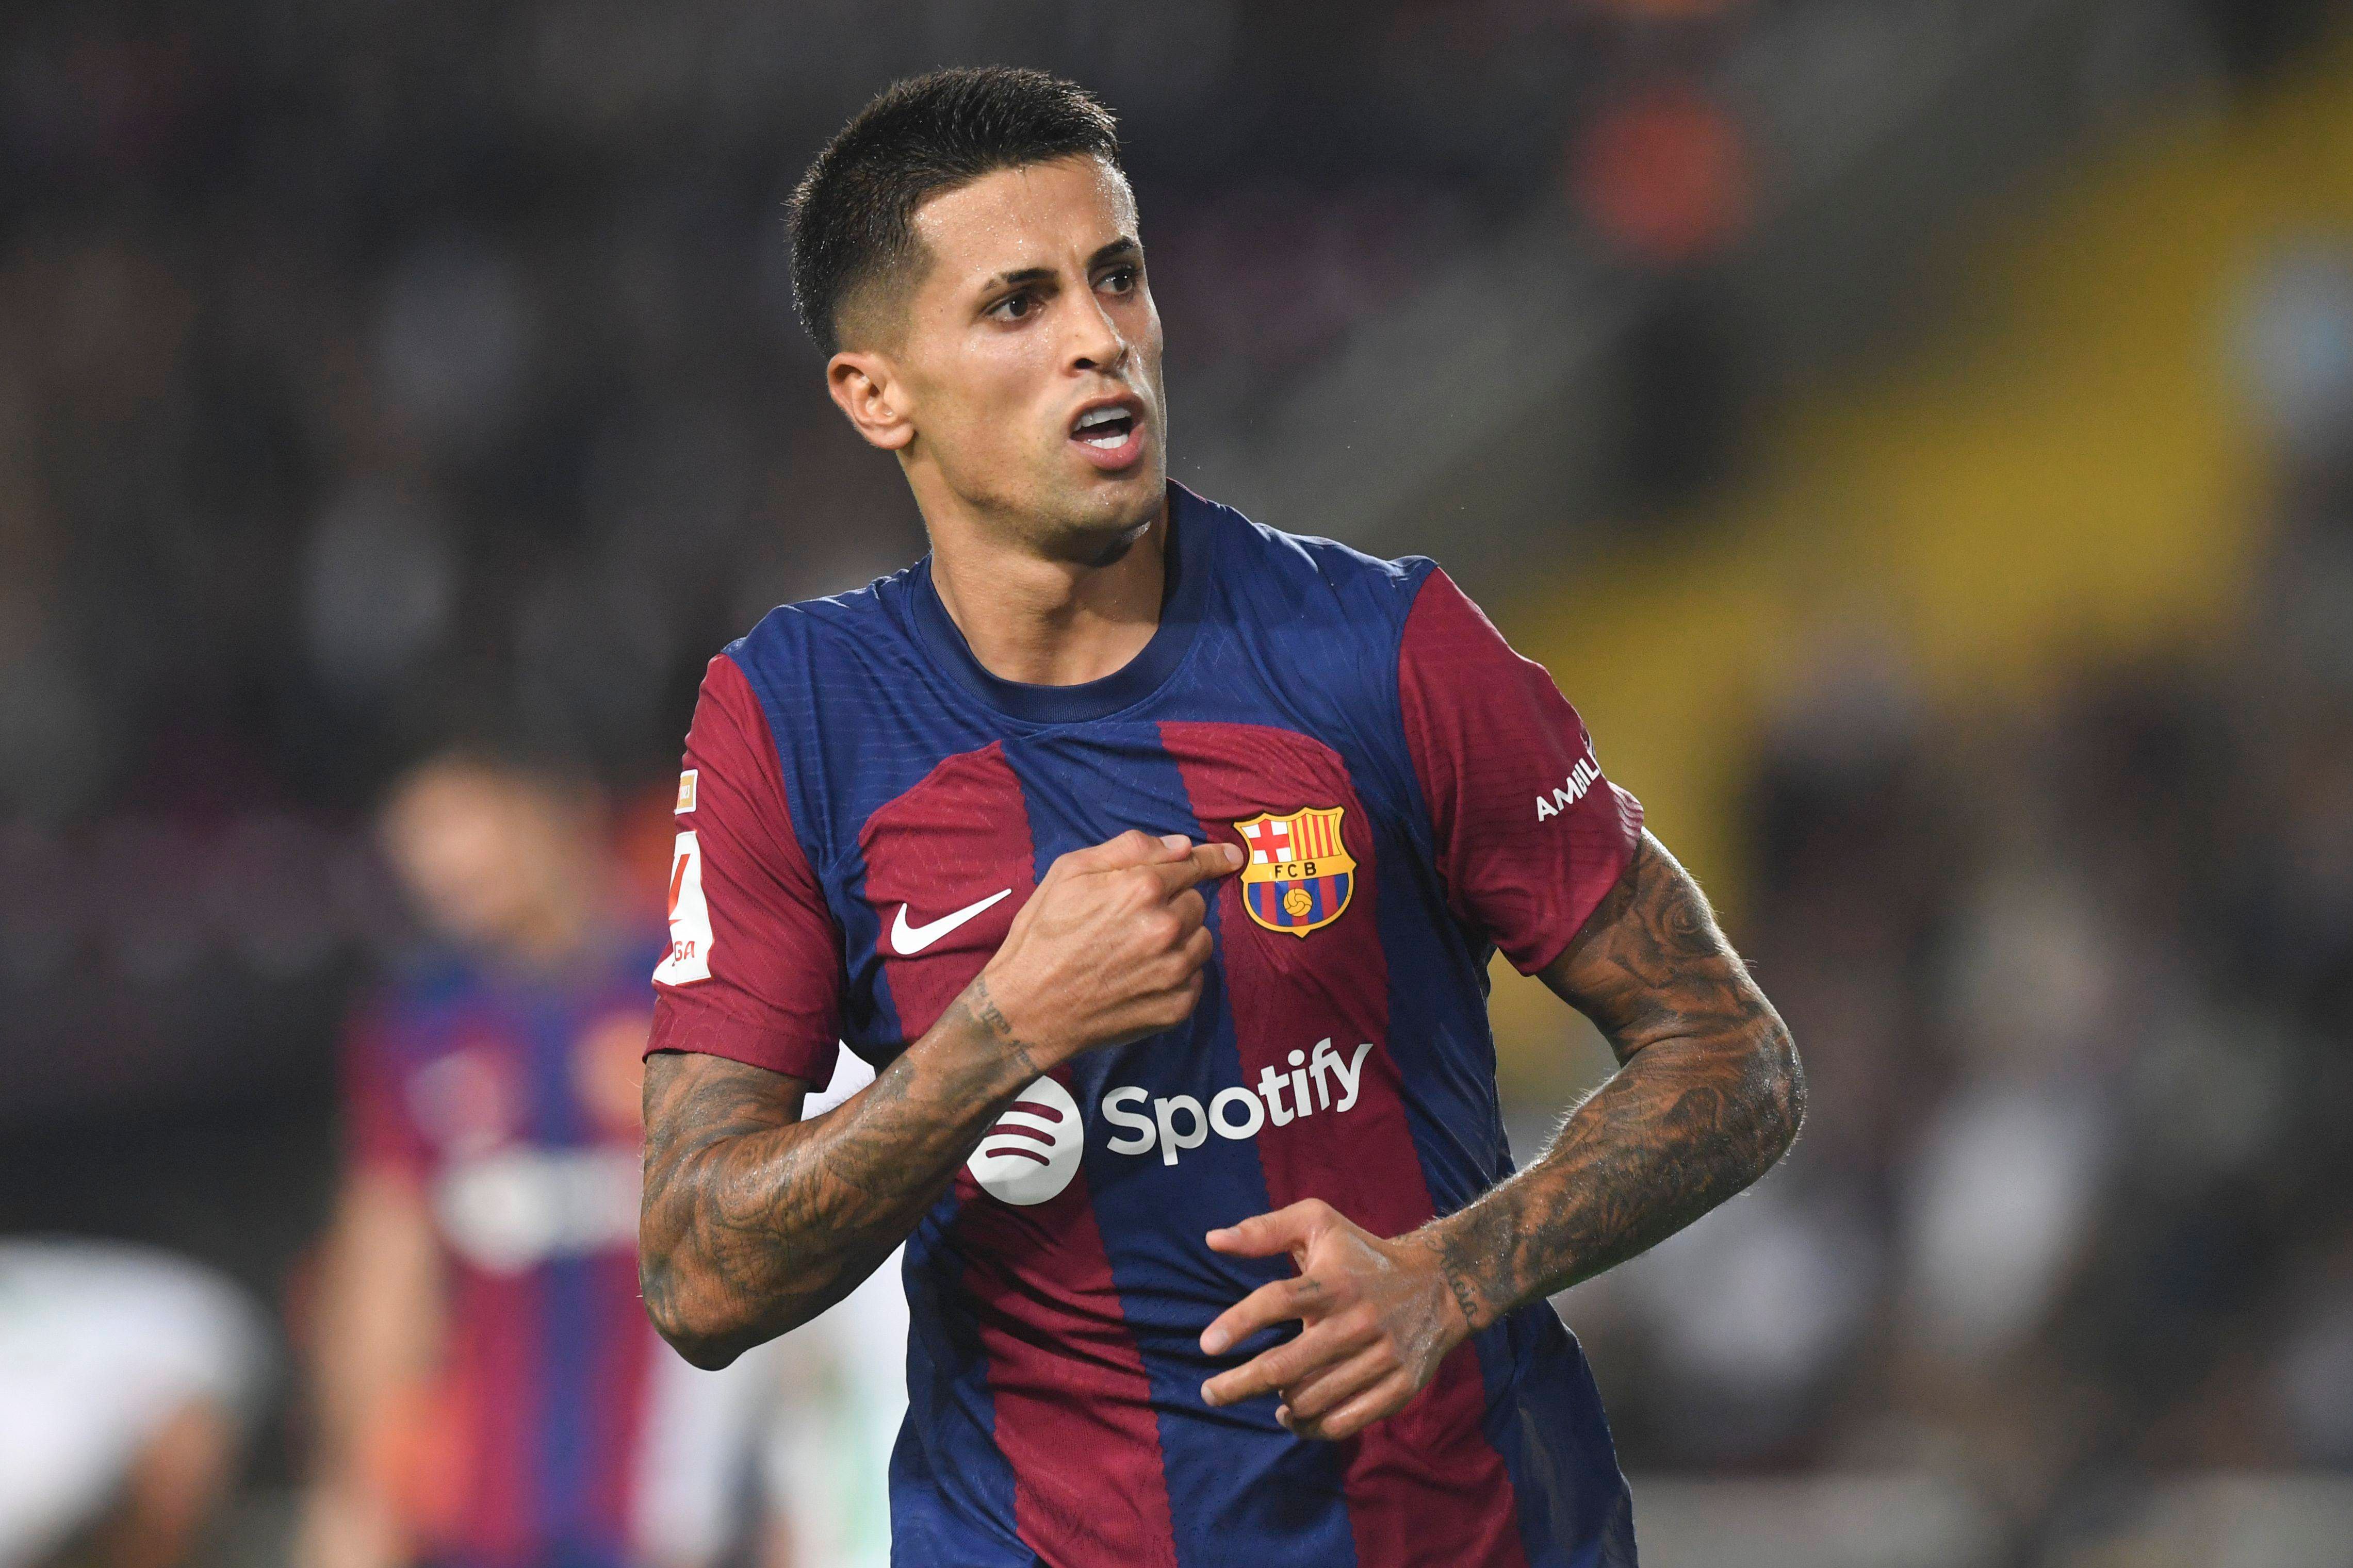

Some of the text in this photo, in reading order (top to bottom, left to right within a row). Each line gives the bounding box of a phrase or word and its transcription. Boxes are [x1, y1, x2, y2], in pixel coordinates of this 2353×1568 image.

[1275, 862, 1316, 878] FCB
[672, 940, 695, 967] GA
[1102, 1037, 1374, 1166] Spotify
